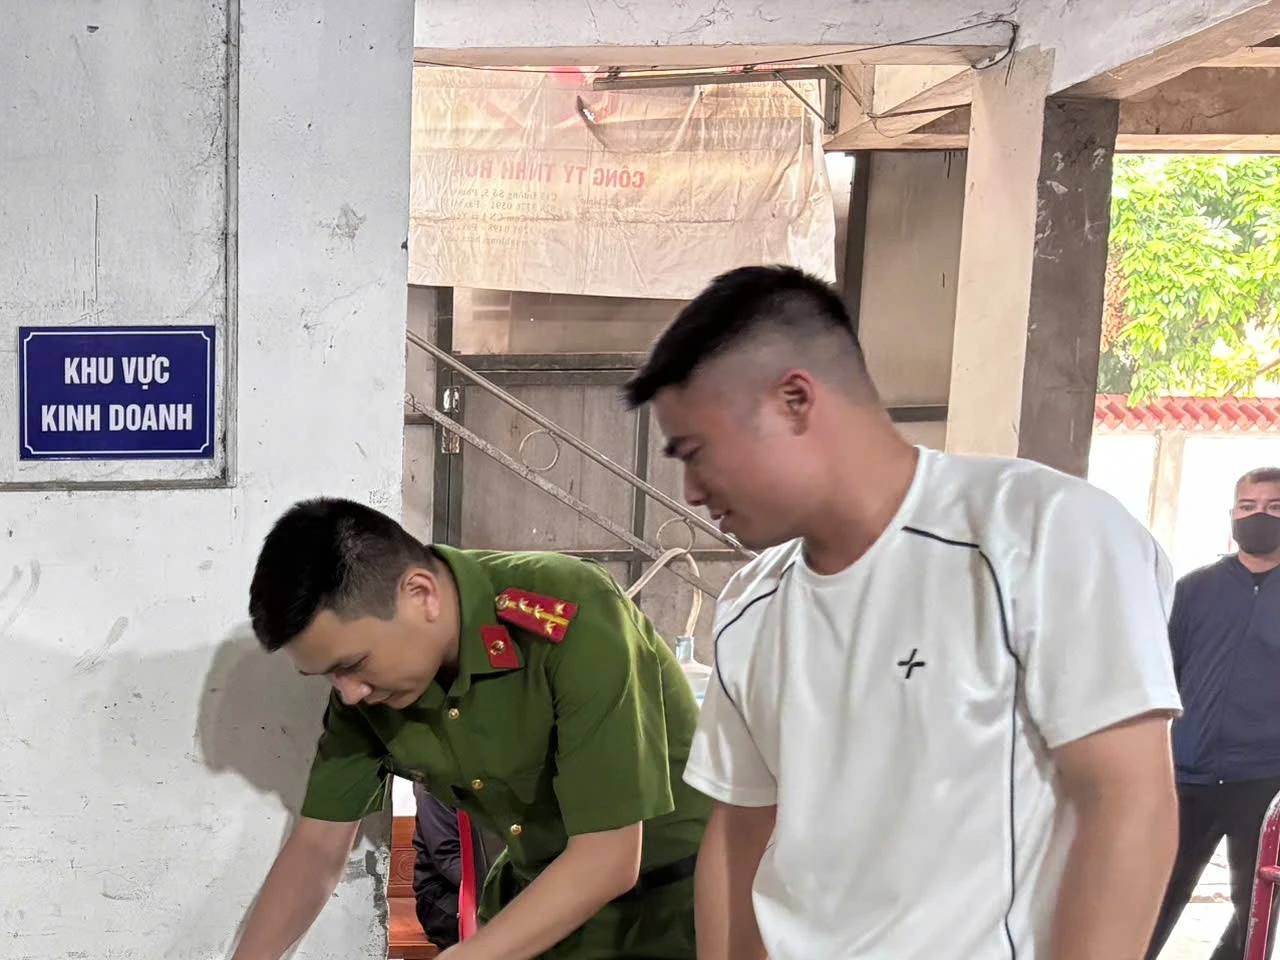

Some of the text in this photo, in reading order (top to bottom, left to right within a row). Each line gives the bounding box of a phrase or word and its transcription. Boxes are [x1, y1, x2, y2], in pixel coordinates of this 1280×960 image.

[64, 354, 170, 390] KHU VỰC
[41, 403, 193, 432] KINH DOANH
